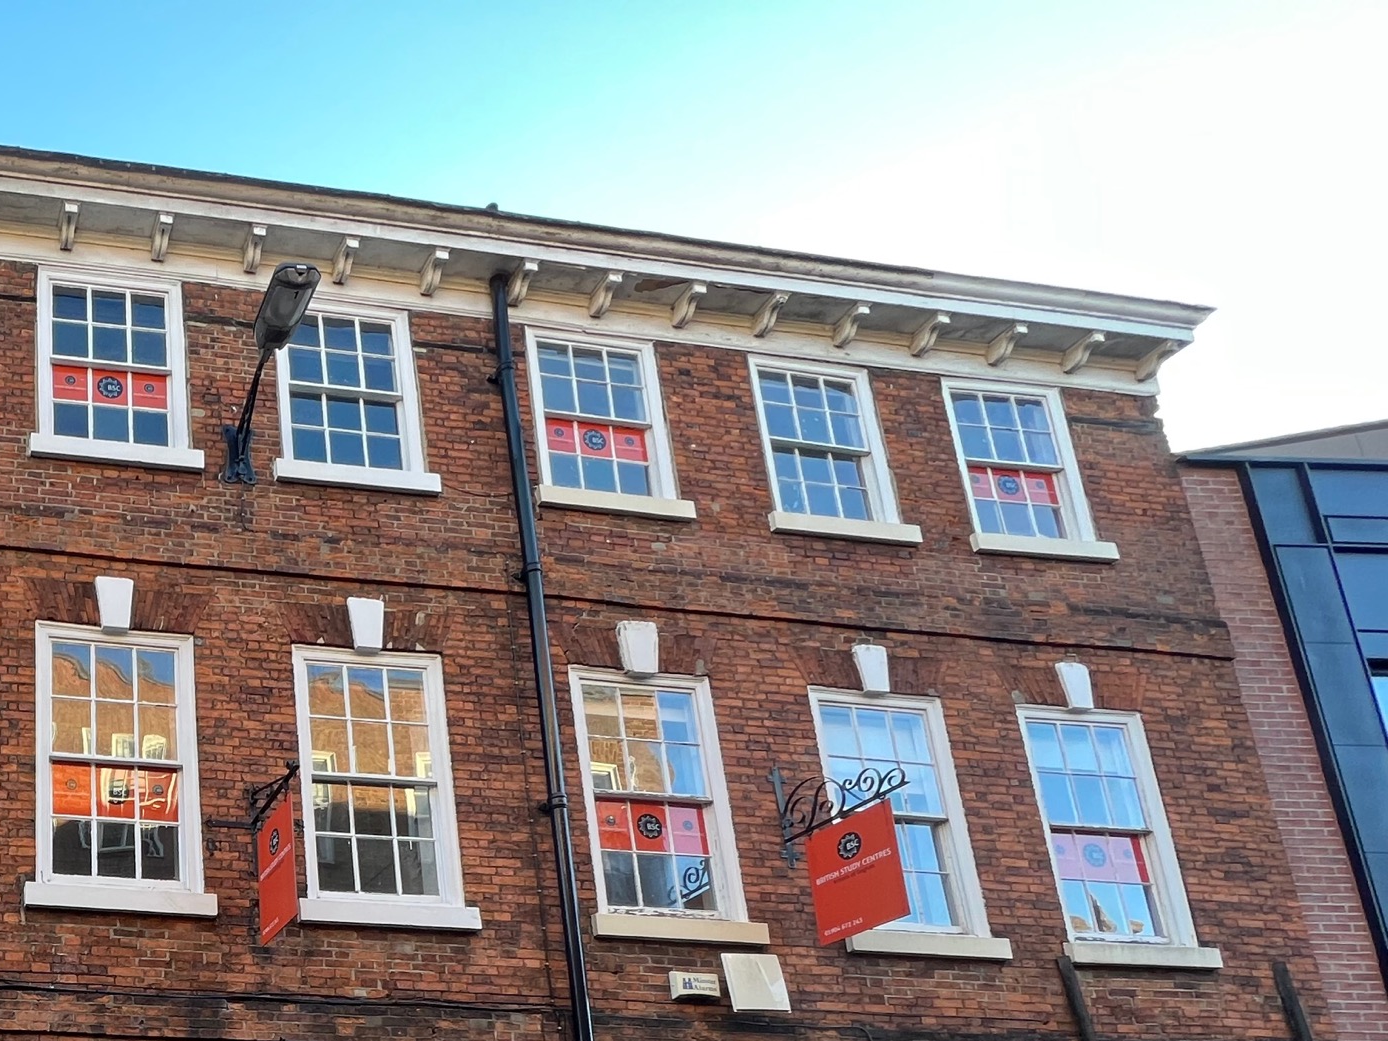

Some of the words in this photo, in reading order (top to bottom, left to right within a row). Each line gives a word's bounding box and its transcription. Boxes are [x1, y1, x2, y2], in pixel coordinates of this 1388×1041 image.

[107, 382, 120, 392] BSC
[646, 823, 660, 831] BSC
[846, 838, 859, 850] BSC
[816, 870, 839, 886] BRITISH
[840, 860, 861, 876] STUDY
[861, 847, 892, 866] CENTRES
